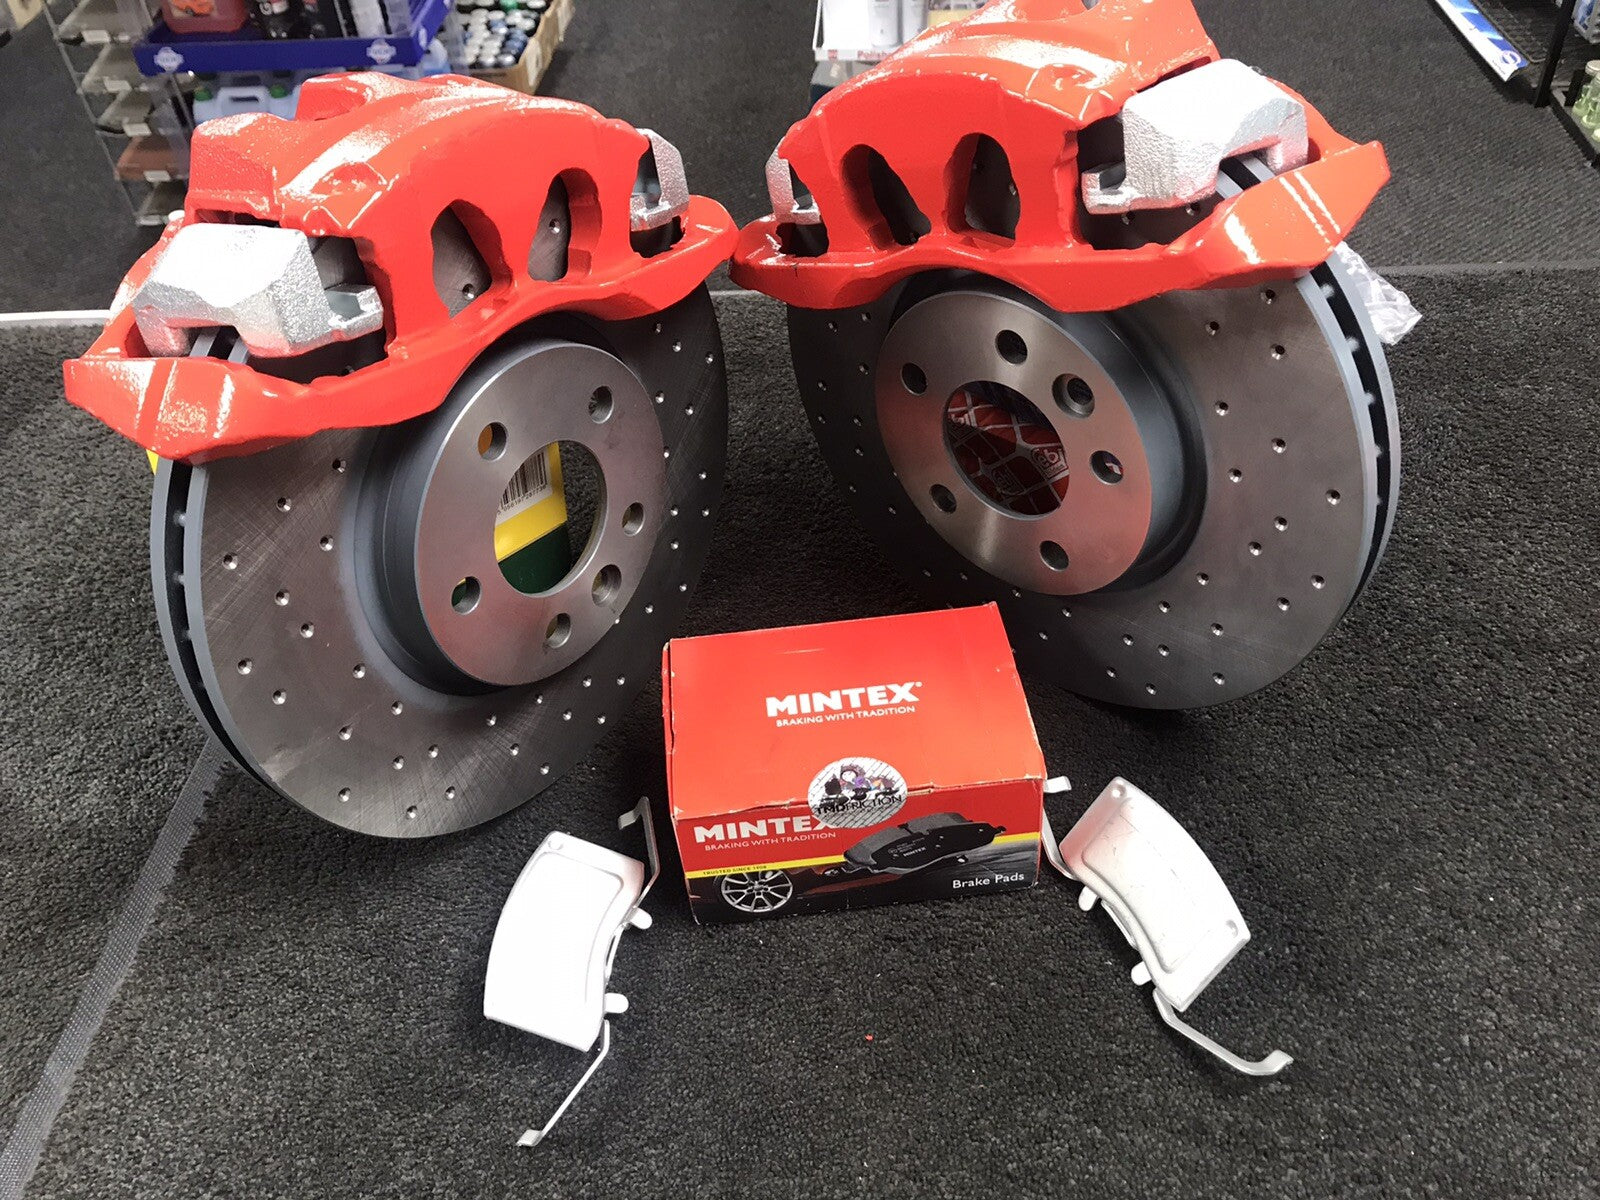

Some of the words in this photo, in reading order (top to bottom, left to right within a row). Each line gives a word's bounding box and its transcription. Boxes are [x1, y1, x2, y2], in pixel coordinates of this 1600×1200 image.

[766, 682, 919, 717] MINTEX
[776, 715, 824, 727] BRAKING
[825, 712, 855, 722] WITH
[856, 706, 916, 718] TRADITION
[705, 841, 750, 851] BRAKING
[750, 837, 779, 847] WITH
[780, 832, 836, 843] TRADITION
[953, 878, 990, 889] Brake
[995, 872, 1025, 884] Pads
